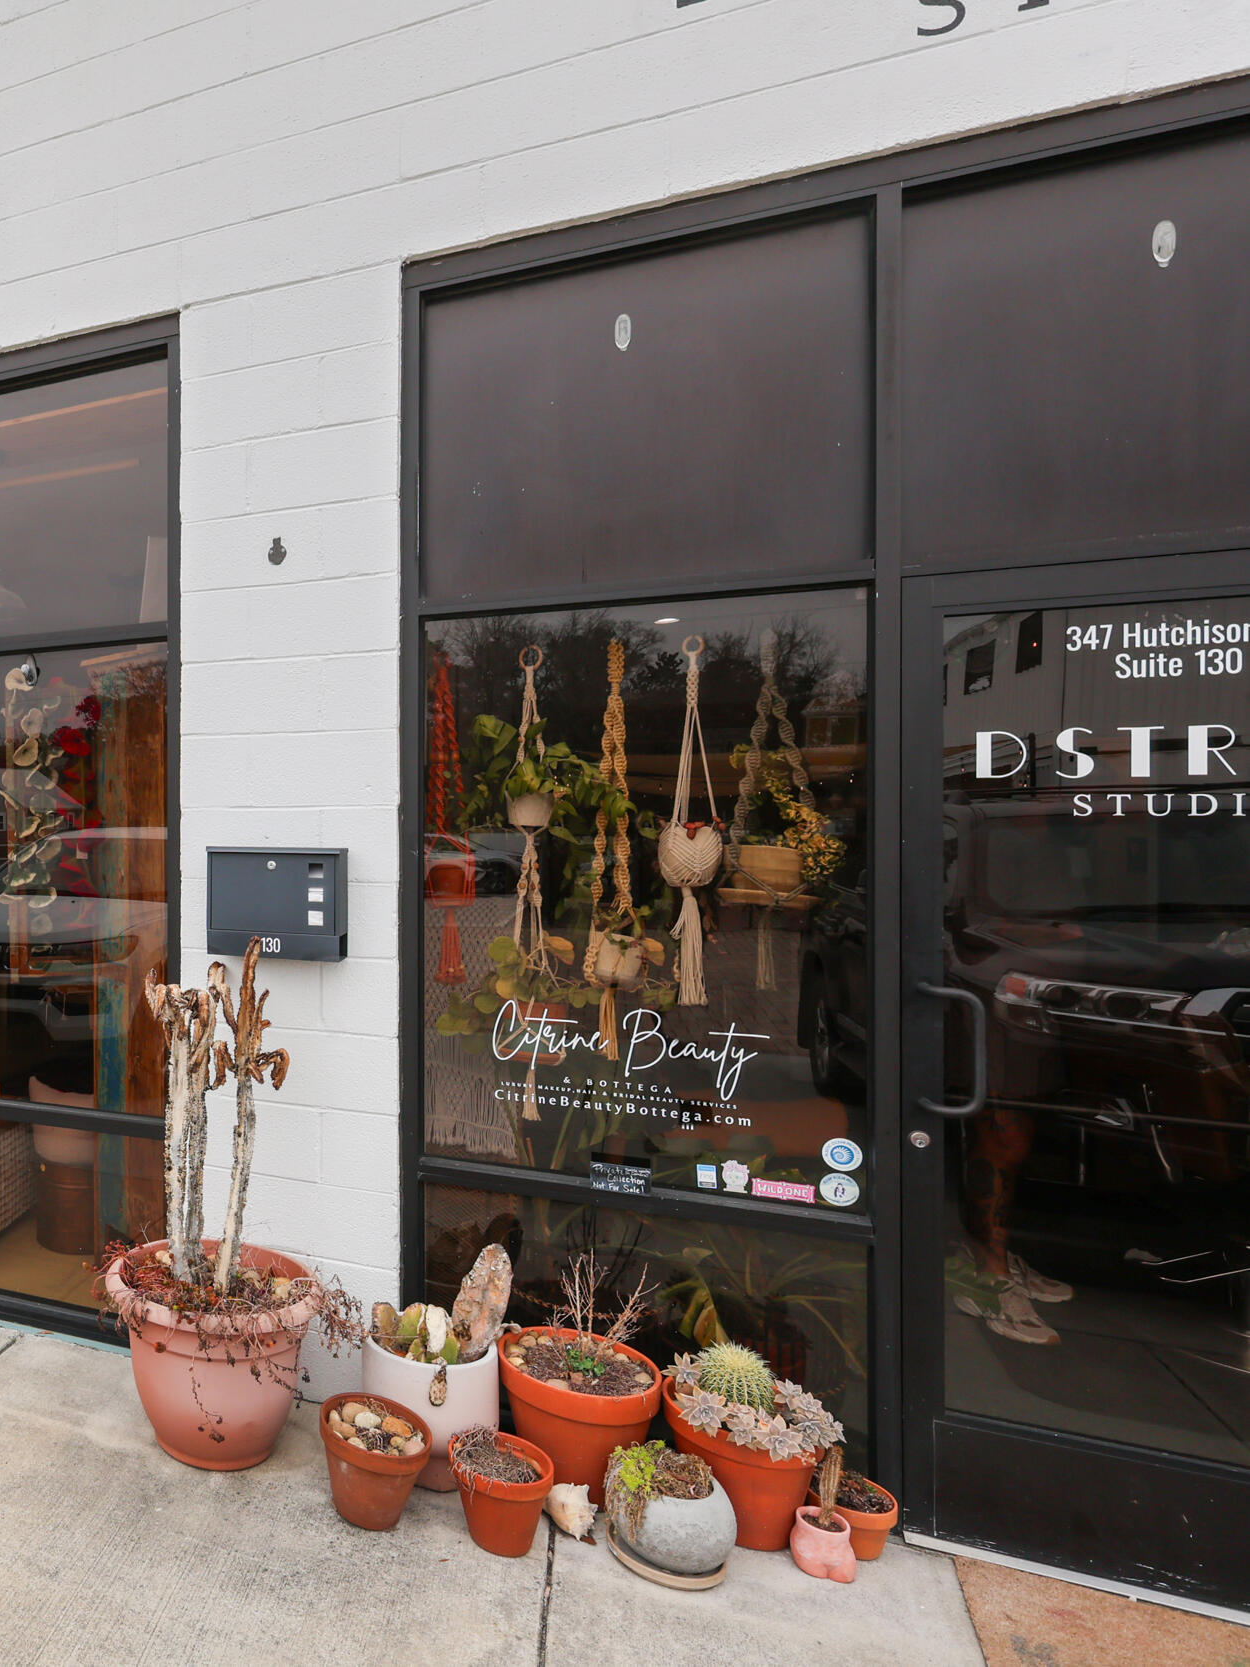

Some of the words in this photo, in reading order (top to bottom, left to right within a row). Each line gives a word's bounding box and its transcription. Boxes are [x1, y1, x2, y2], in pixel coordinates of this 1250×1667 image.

[1066, 624, 1113, 651] 347
[1114, 653, 1183, 679] Suite
[1195, 647, 1243, 676] 130
[976, 724, 1237, 779] DSTR
[1073, 793, 1247, 817] STUDI
[261, 937, 281, 953] 130
[492, 1000, 609, 1070] Citrine
[622, 1008, 770, 1101] Beauty
[563, 1076, 572, 1084] &
[586, 1078, 672, 1094] BOTTEGA
[494, 1089, 751, 1127] CitrineBeautyBottega.com
[650, 1096, 685, 1105] BEAUTY
[690, 1100, 737, 1110] SERVICES
[757, 1183, 783, 1194] WILD
[785, 1187, 810, 1198] ONE
